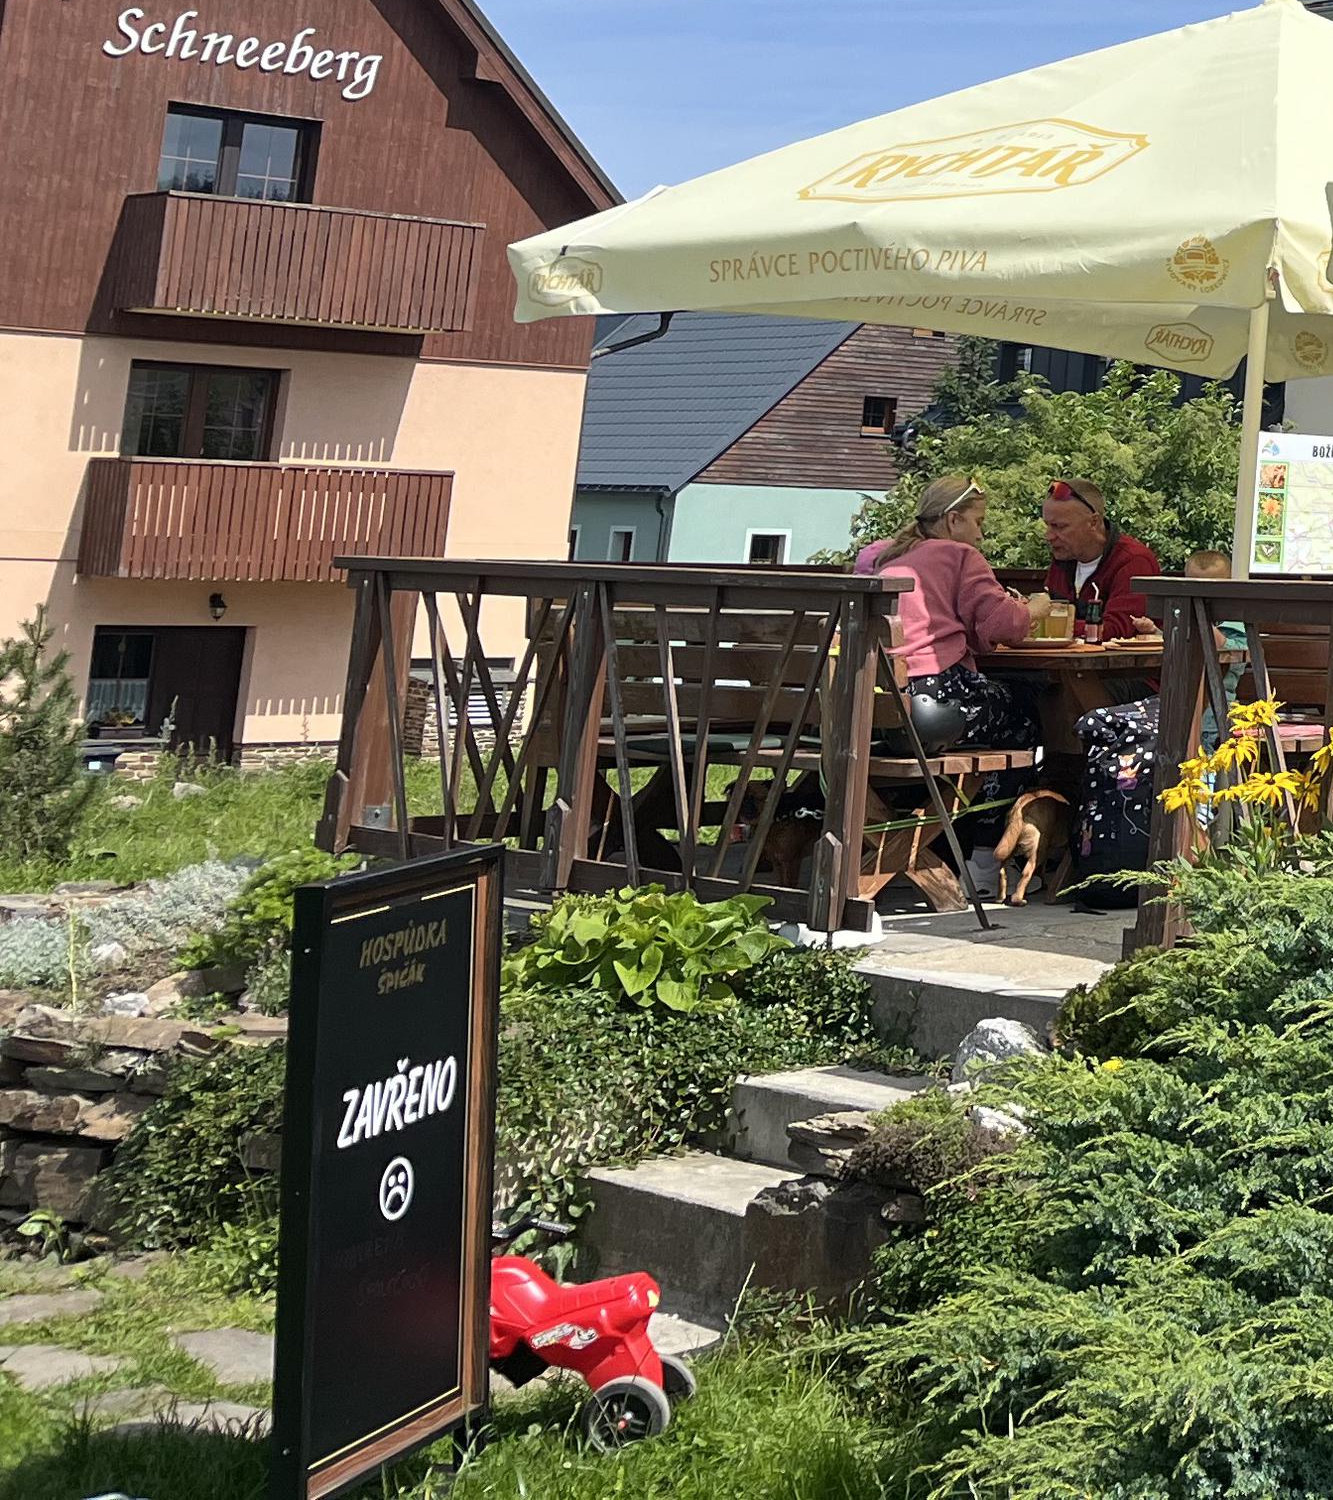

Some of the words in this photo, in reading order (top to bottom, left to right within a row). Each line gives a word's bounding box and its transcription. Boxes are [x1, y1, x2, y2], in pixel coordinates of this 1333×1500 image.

[102, 7, 383, 100] Schneeberg
[835, 143, 1119, 189] RYCHTÁŘ
[532, 267, 598, 295] RYCHTÁŘ
[709, 250, 799, 283] SPRÁVCE
[808, 241, 930, 276] POCTIVÉHO
[935, 249, 988, 272] PIVA
[336, 1056, 458, 1150] ZAVŘENO
